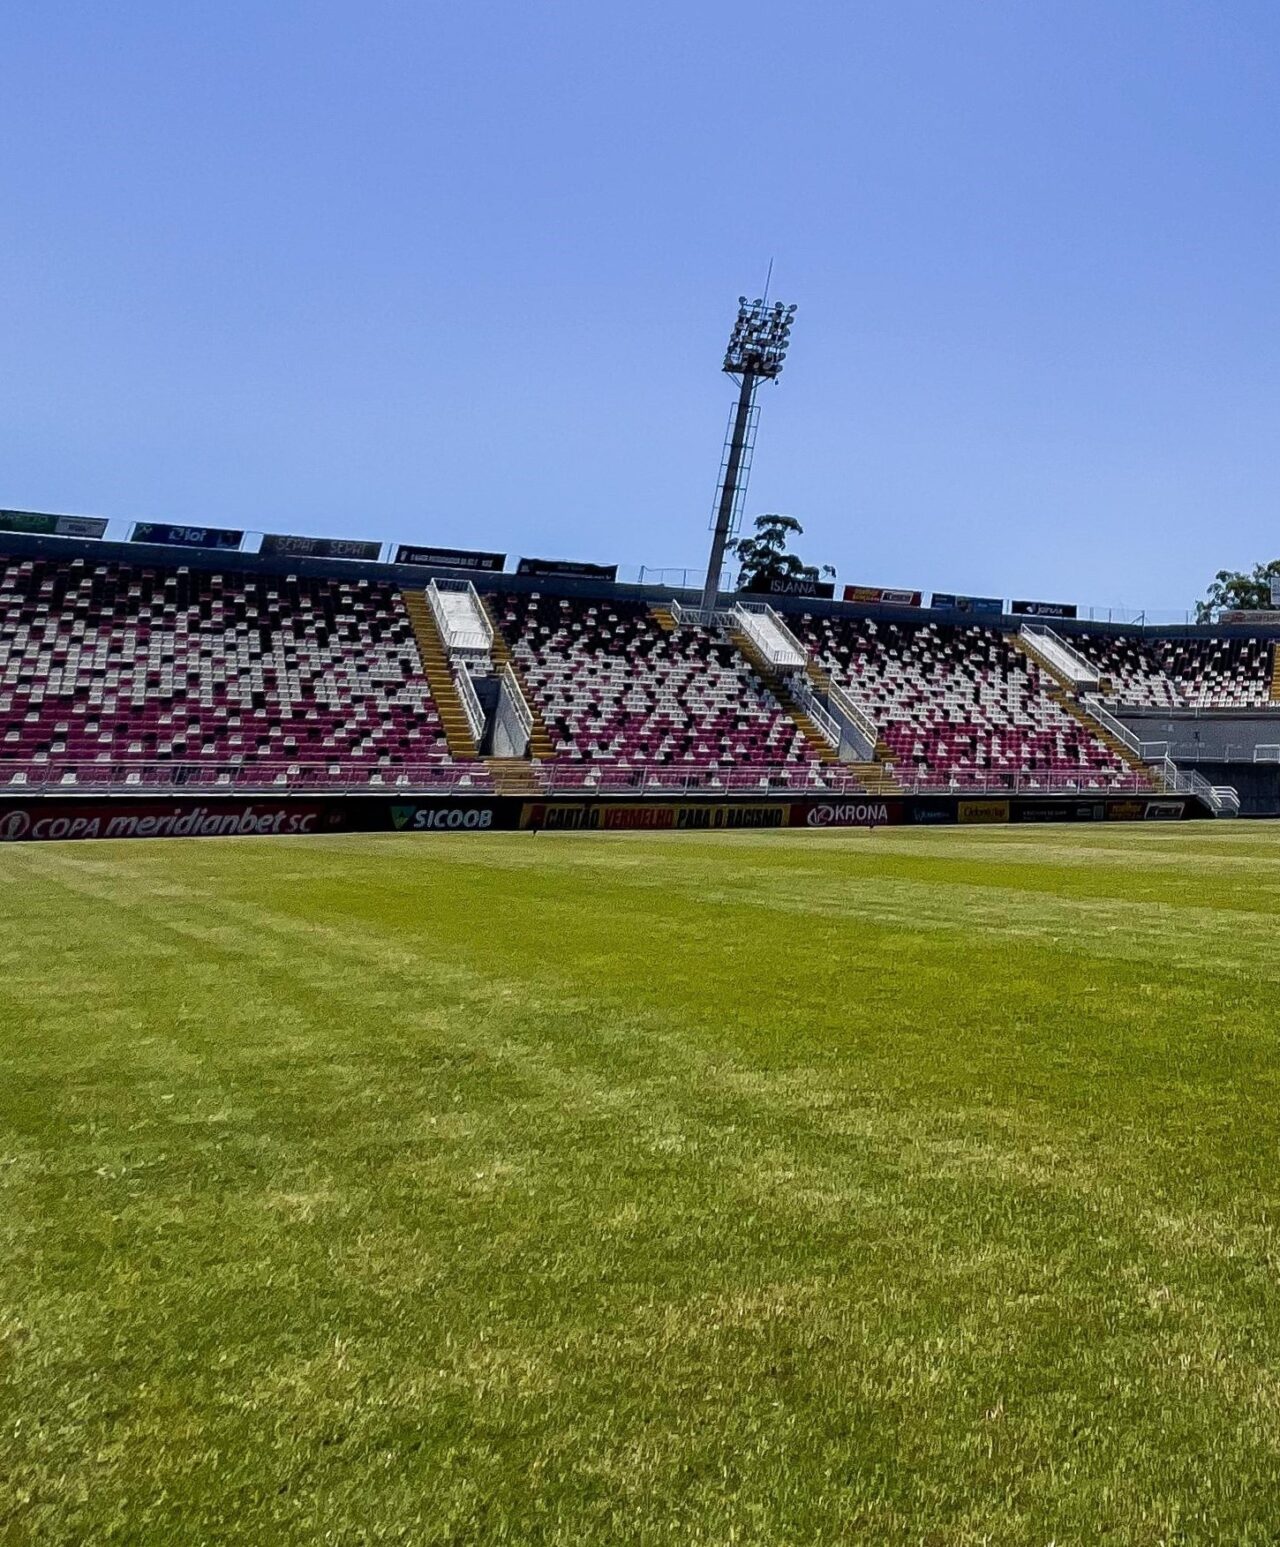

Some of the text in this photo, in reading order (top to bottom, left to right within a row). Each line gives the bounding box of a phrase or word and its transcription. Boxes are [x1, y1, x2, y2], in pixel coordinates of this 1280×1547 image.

[413, 809, 493, 828] SICOOB
[834, 804, 887, 821] KRONA
[31, 817, 101, 838] COPA
[104, 807, 286, 836] meridianbet
